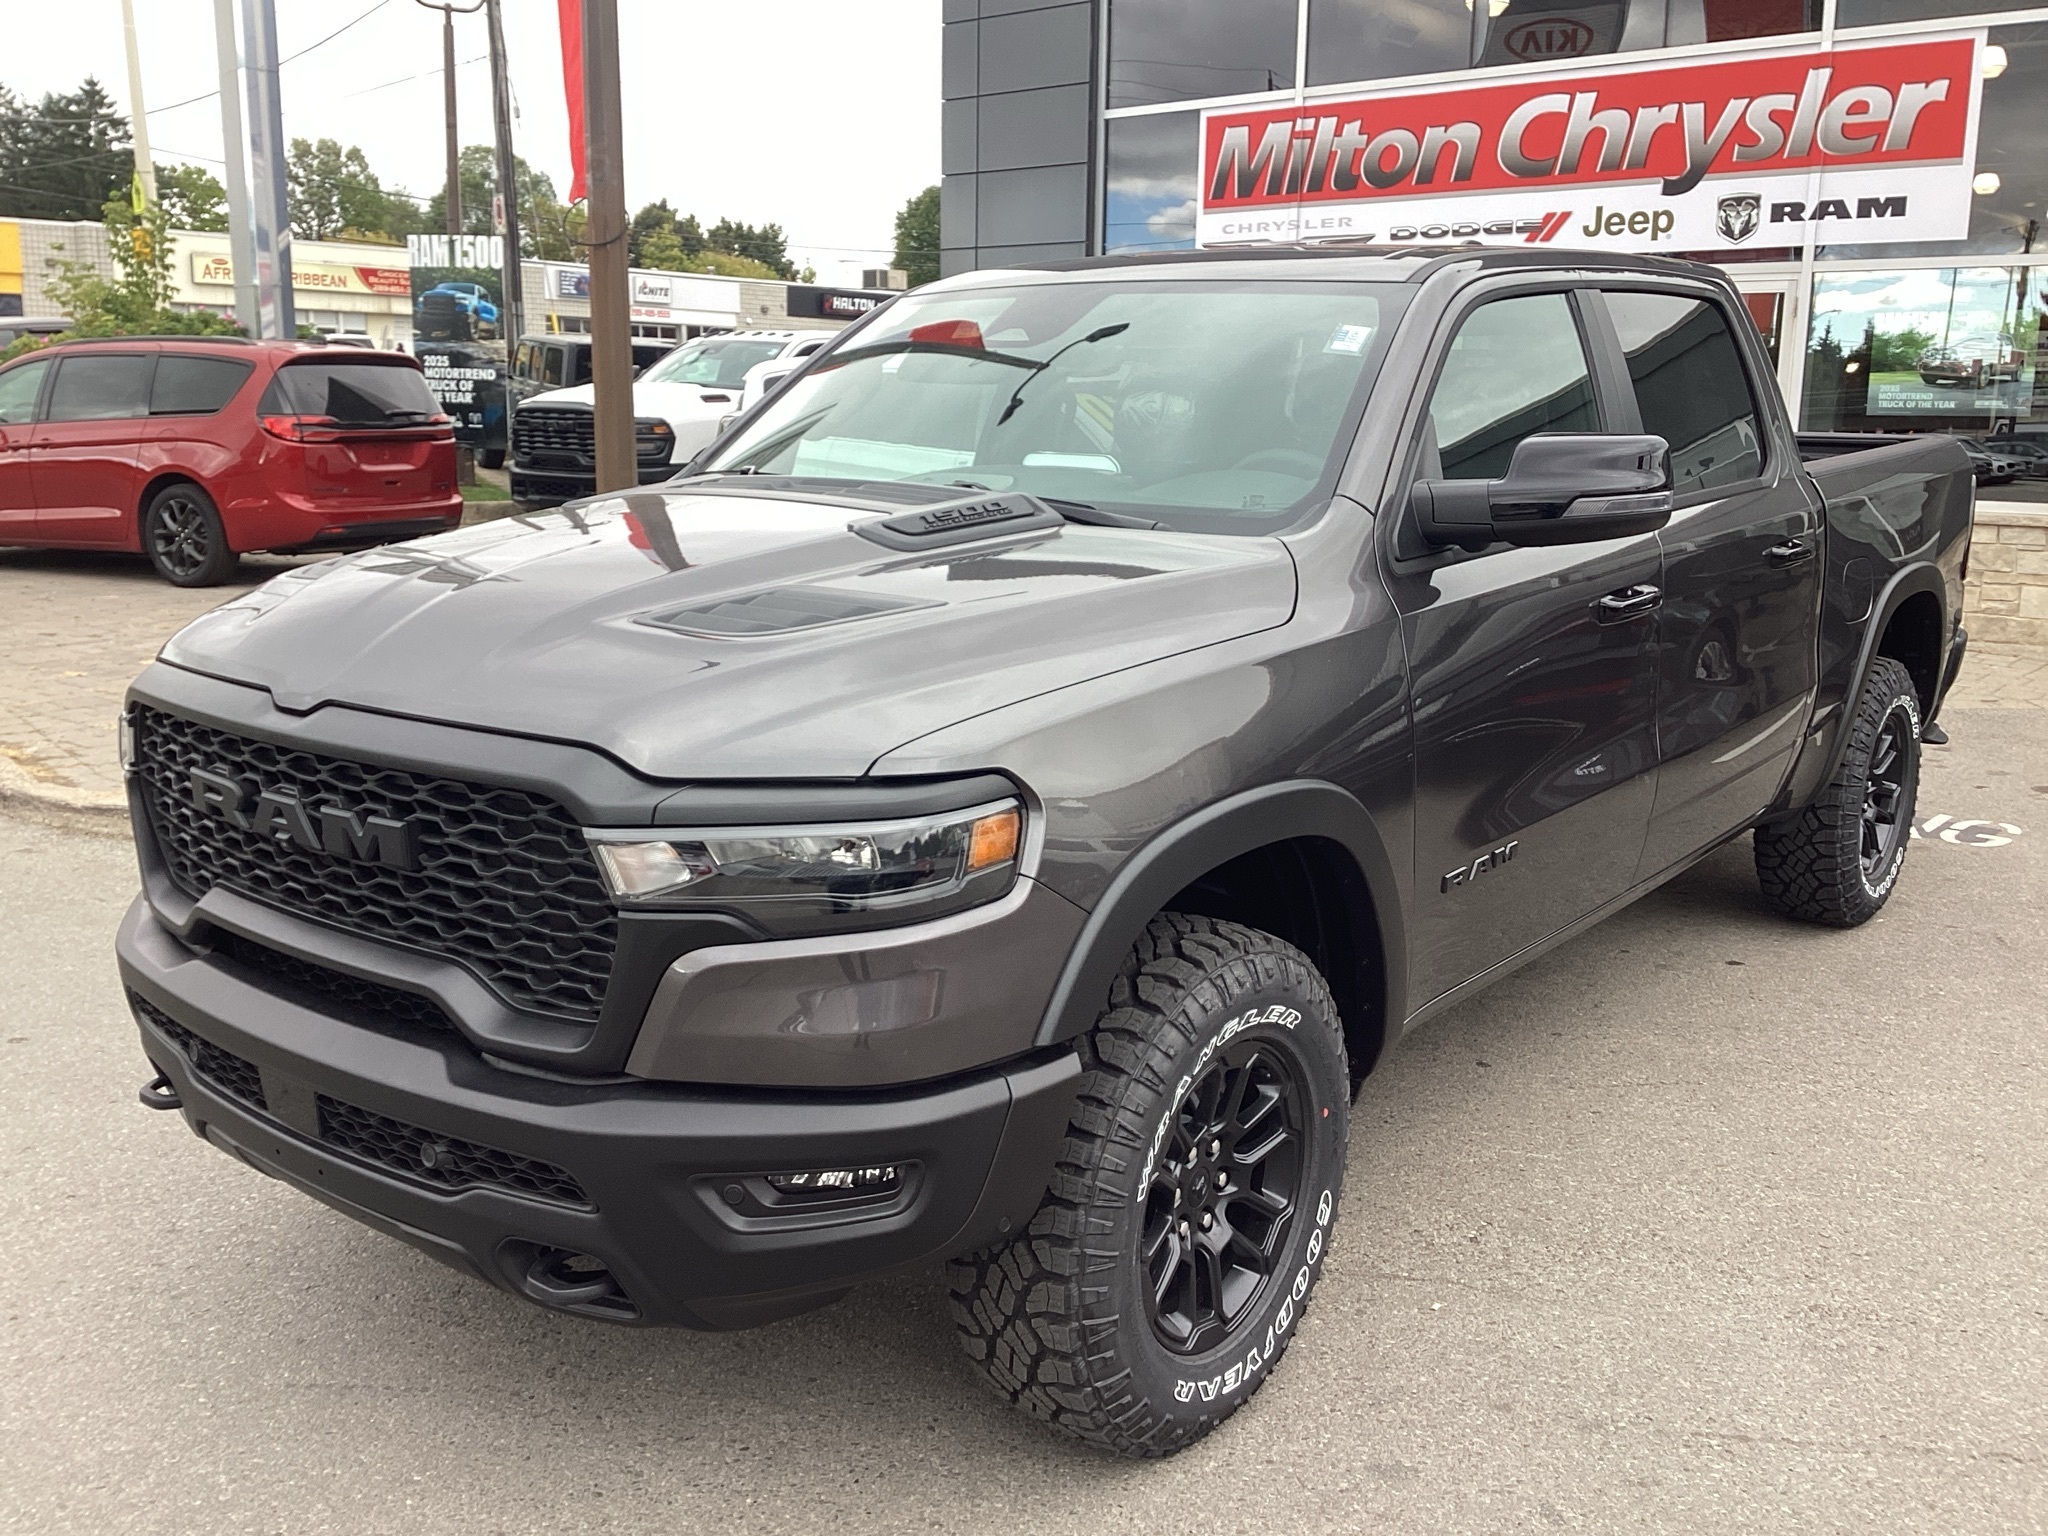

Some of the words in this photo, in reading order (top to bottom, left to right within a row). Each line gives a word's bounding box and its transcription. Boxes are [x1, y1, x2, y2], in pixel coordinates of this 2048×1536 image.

[1210, 115, 1482, 200] Milton
[1497, 67, 1951, 196] Chrysler
[1770, 196, 1907, 223] RAM
[1222, 216, 1353, 234] CHRYSLER
[1390, 218, 1544, 240] DODGE
[1582, 205, 1674, 240] Jeep
[407, 234, 450, 267] RAM
[452, 235, 504, 269] 1500
[202, 264, 232, 280] AFR
[292, 271, 347, 288] RIBBEAN
[638, 285, 669, 297] IGNITE
[832, 296, 876, 311] HALTON
[423, 354, 450, 367] 2025
[424, 367, 496, 380] MOTORTREND
[459, 380, 474, 391] OF
[1878, 392, 1933, 400] MOTORTREND
[1878, 400, 1904, 408] TRUCK
[1905, 400, 1916, 408] OF
[1918, 400, 1932, 408] THE
[1933, 401, 1956, 409] YEAR
[919, 501, 1008, 525] 1500
[190, 766, 410, 868] RAM
[1440, 840, 1518, 894] RAM
[1137, 1005, 1302, 1202] WRANGLER
[1174, 1190, 1332, 1402] GOODYEAR
